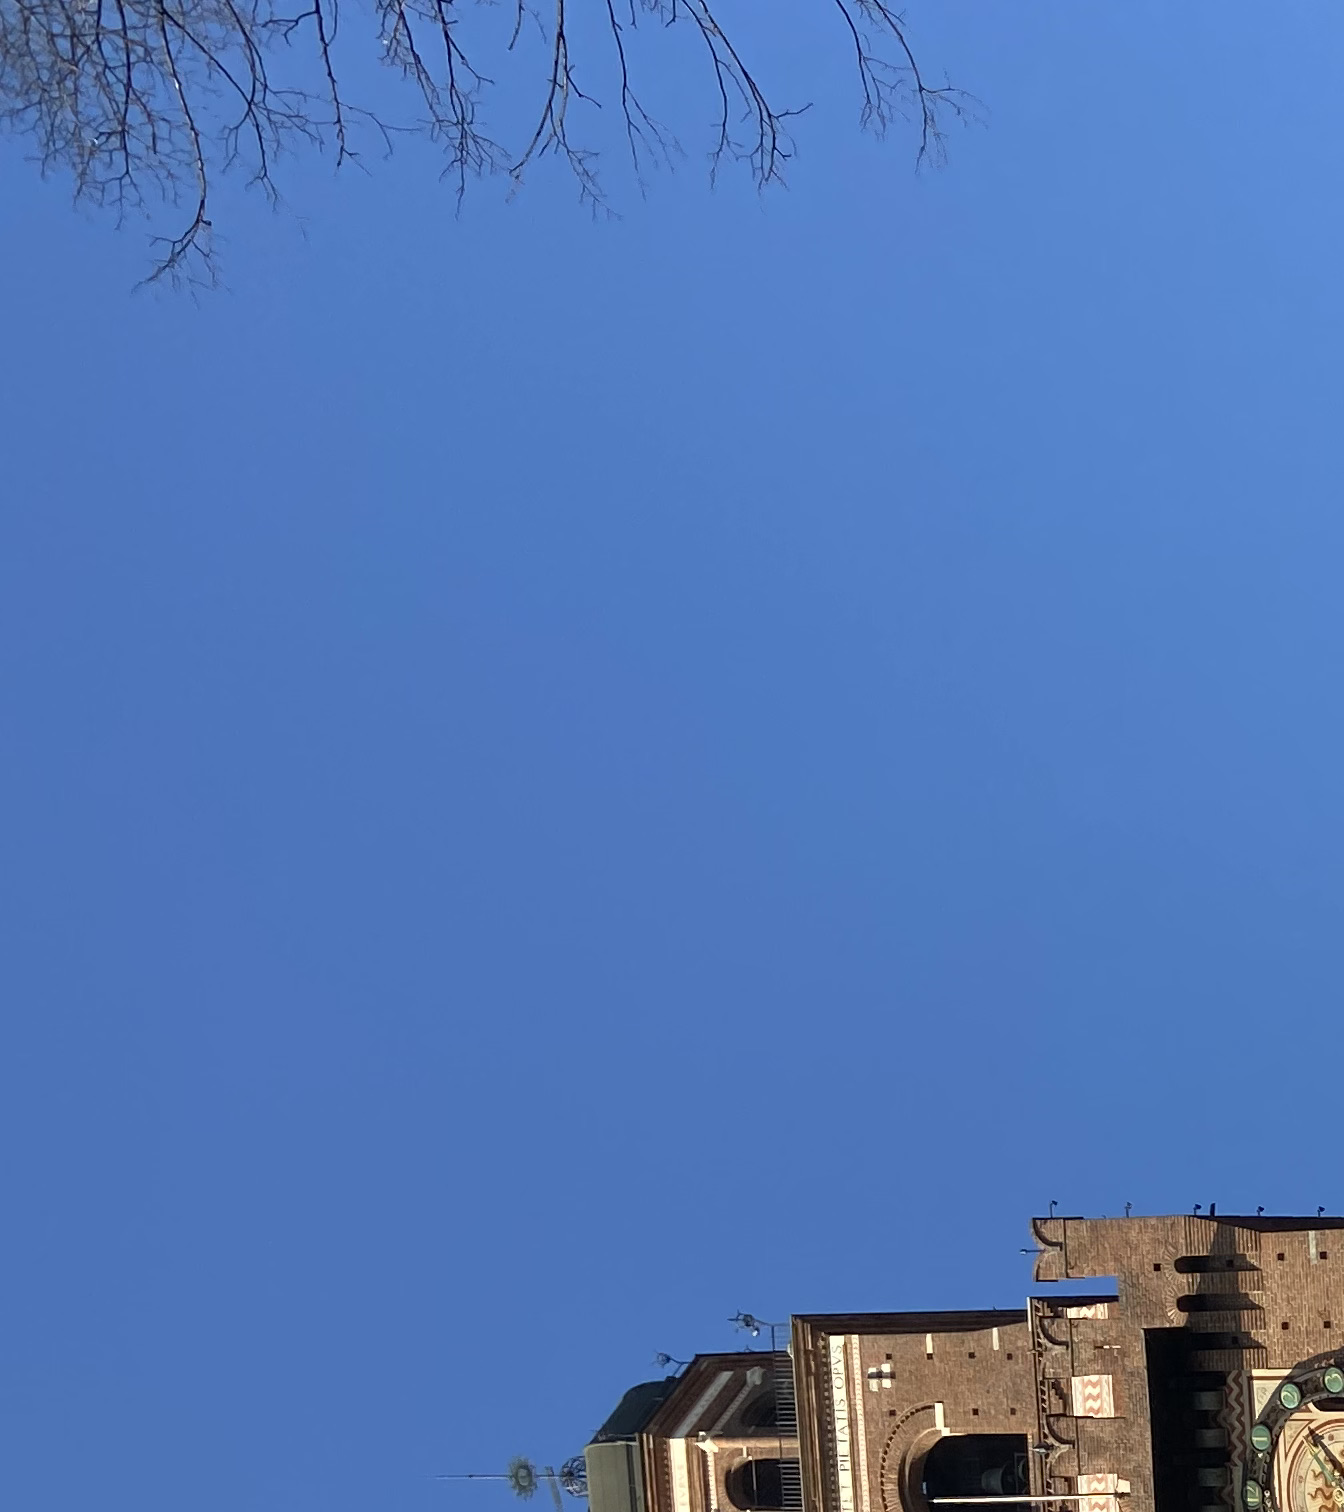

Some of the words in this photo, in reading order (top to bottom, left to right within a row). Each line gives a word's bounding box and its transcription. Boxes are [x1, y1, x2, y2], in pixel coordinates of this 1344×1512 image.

[831, 1344, 845, 1390] OPVS
[1325, 1373, 1344, 1385] 3
[1281, 1391, 1297, 1403] 2
[834, 1398, 850, 1472] PIETATIS
[1246, 1486, 1259, 1502] 12
